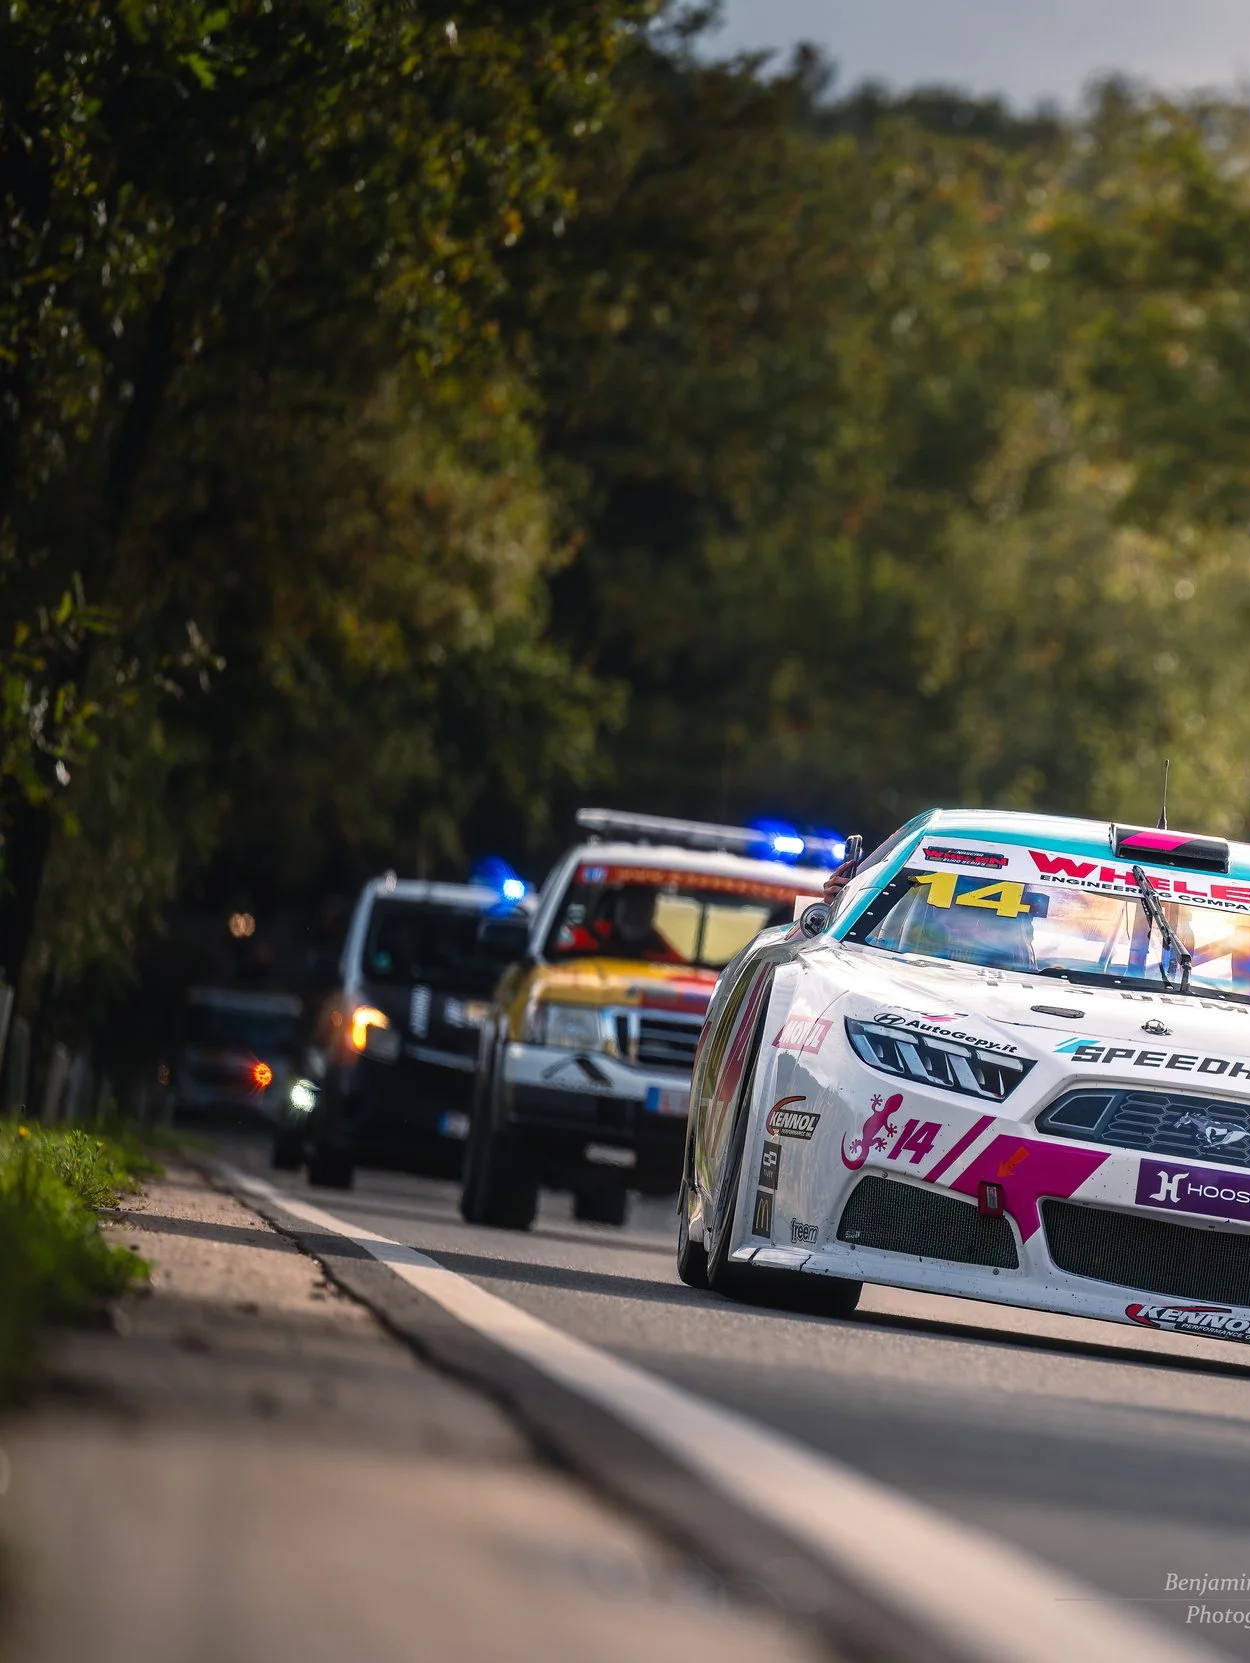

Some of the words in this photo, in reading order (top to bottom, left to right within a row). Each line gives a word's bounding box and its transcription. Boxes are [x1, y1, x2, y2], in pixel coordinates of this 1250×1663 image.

[915, 872, 1030, 918] 14
[1040, 874, 1172, 898] ENGINEERIG
[779, 1020, 826, 1048] MOTUL
[905, 1020, 1018, 1054] AutoGepy.it
[769, 1111, 816, 1131] KENNOL
[887, 1118, 942, 1164] 14
[1181, 1323, 1244, 1338] PERFORMANCE
